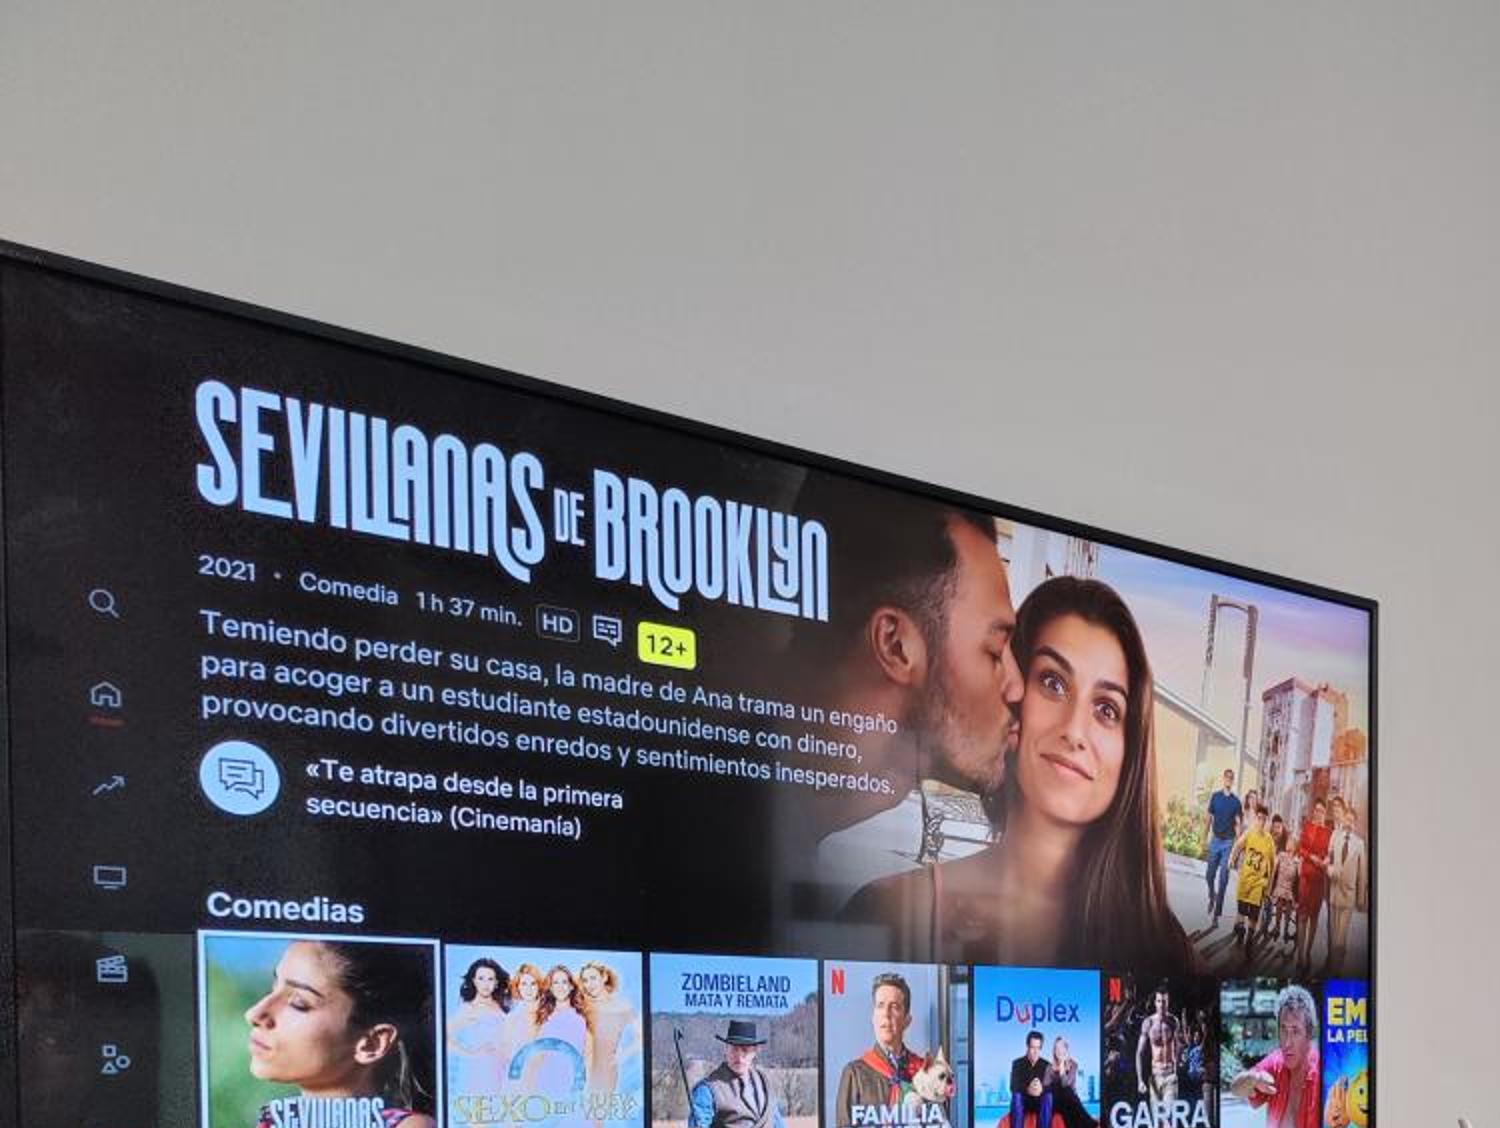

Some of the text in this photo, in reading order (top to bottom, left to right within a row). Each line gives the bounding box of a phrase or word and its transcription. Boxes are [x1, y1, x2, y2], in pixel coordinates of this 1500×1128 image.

[195, 380, 829, 623] SEVILLANAS DE BROOKLYN
[198, 555, 256, 582] 2021
[299, 572, 399, 605] Comedia
[449, 598, 475, 618] 37
[480, 604, 523, 627] min.
[542, 614, 574, 634] HD
[646, 634, 688, 657] 12+
[199, 608, 898, 735] Temiendo perder su casa, la madre de Ana trama un engaño
[201, 654, 863, 763] para acoger a un estudiante estadounidense con dinero,
[202, 694, 897, 796] provocando divertidos enredos y sentimientos inesperados.
[306, 758, 624, 811] «Te atrapa desde la primera
[306, 796, 582, 840] secuencia» (Cinemanía)
[206, 891, 365, 924] Comedias
[681, 972, 791, 993] ZOMBIELAND
[831, 968, 845, 994] N
[684, 993, 789, 1010] MATA Y REMATA
[996, 995, 1080, 1028] Duplex
[1326, 1029, 1345, 1044] LA
[851, 1103, 944, 1126] FAMILIA
